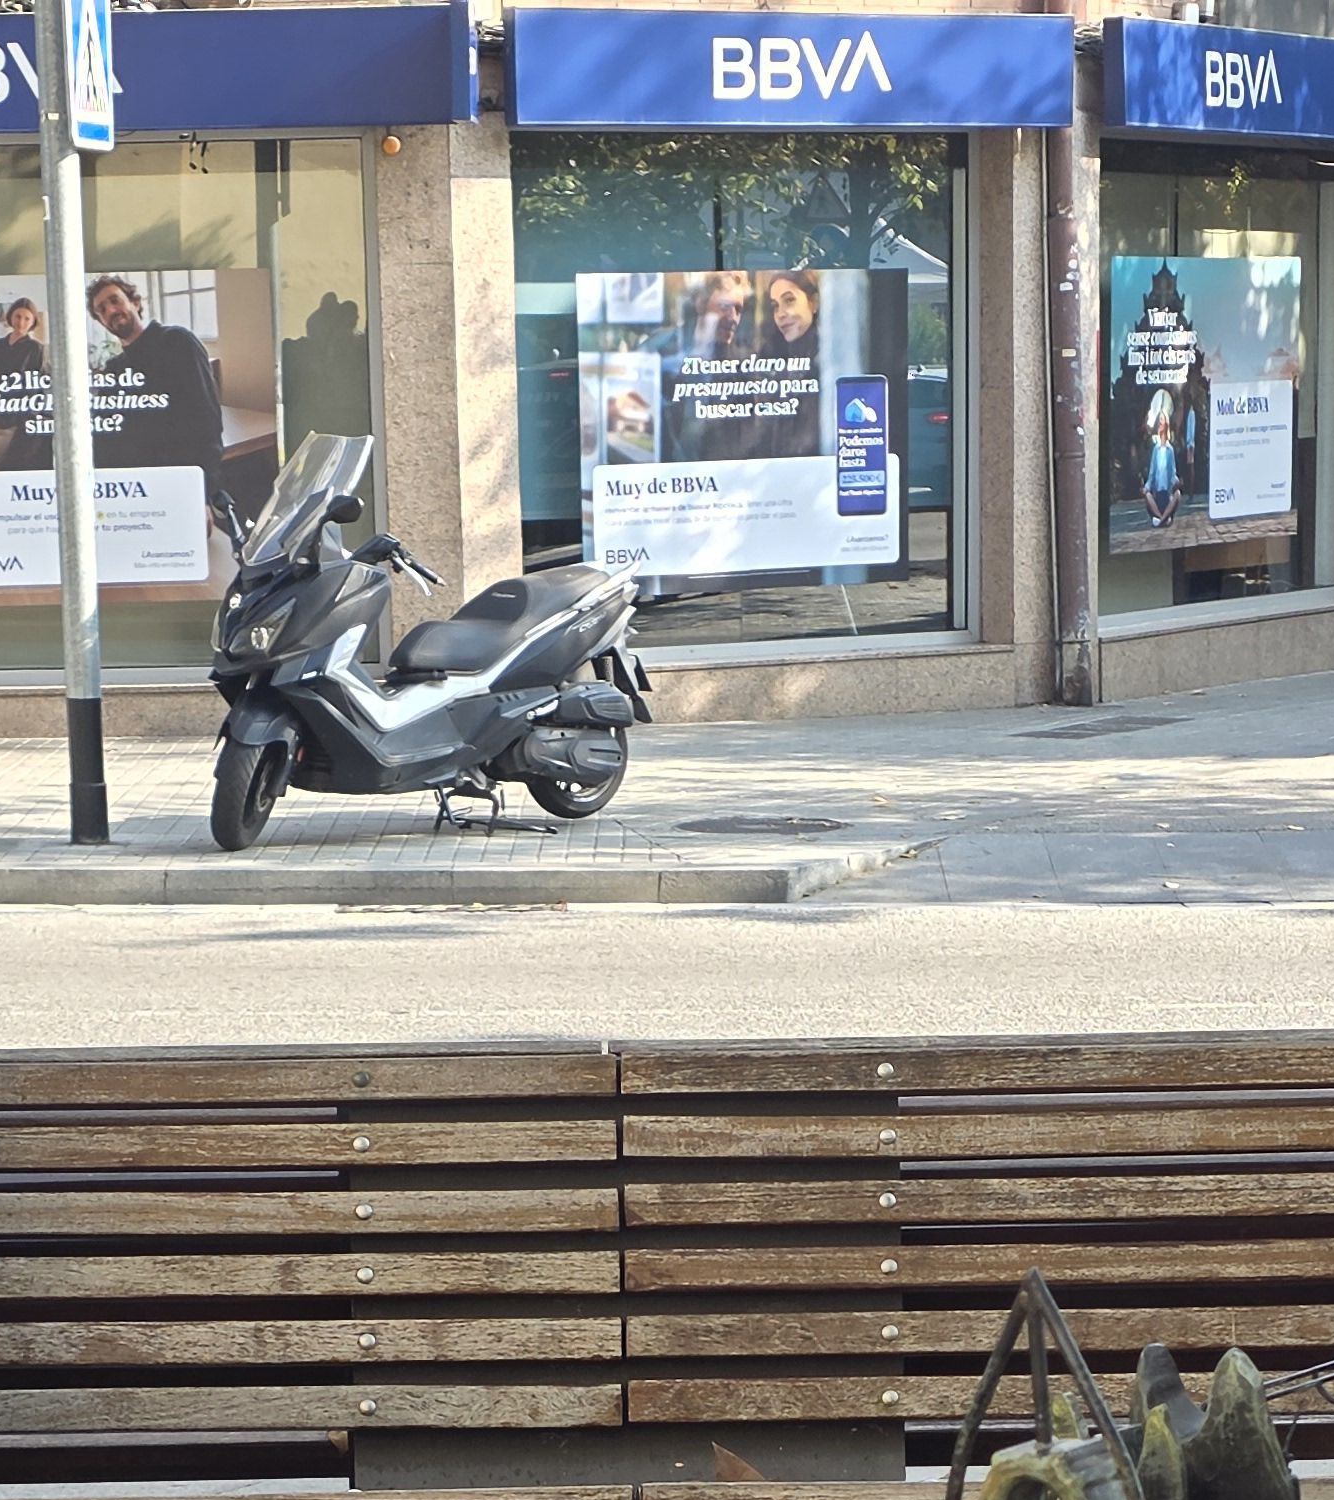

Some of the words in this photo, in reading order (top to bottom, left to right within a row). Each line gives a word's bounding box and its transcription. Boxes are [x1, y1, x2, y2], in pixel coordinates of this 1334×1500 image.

[712, 31, 892, 100] BBVA
[1205, 49, 1283, 109] BBVA
[681, 356, 740, 375] ¿Tener
[741, 354, 786, 373] claro
[787, 356, 811, 372] un
[0, 372, 23, 392] ¿2
[25, 368, 116, 389] licias
[119, 368, 145, 387] de
[672, 378, 778, 402] presupuesto
[779, 378, 819, 398] para
[695, 400, 753, 419] buscar
[754, 398, 800, 416] casa?
[10, 484, 57, 505] Muy
[605, 480, 645, 500] Muy
[647, 477, 668, 494] de
[671, 476, 719, 494] BBVA
[1214, 487, 1236, 504] BBVA
[605, 547, 650, 564] BBVA
